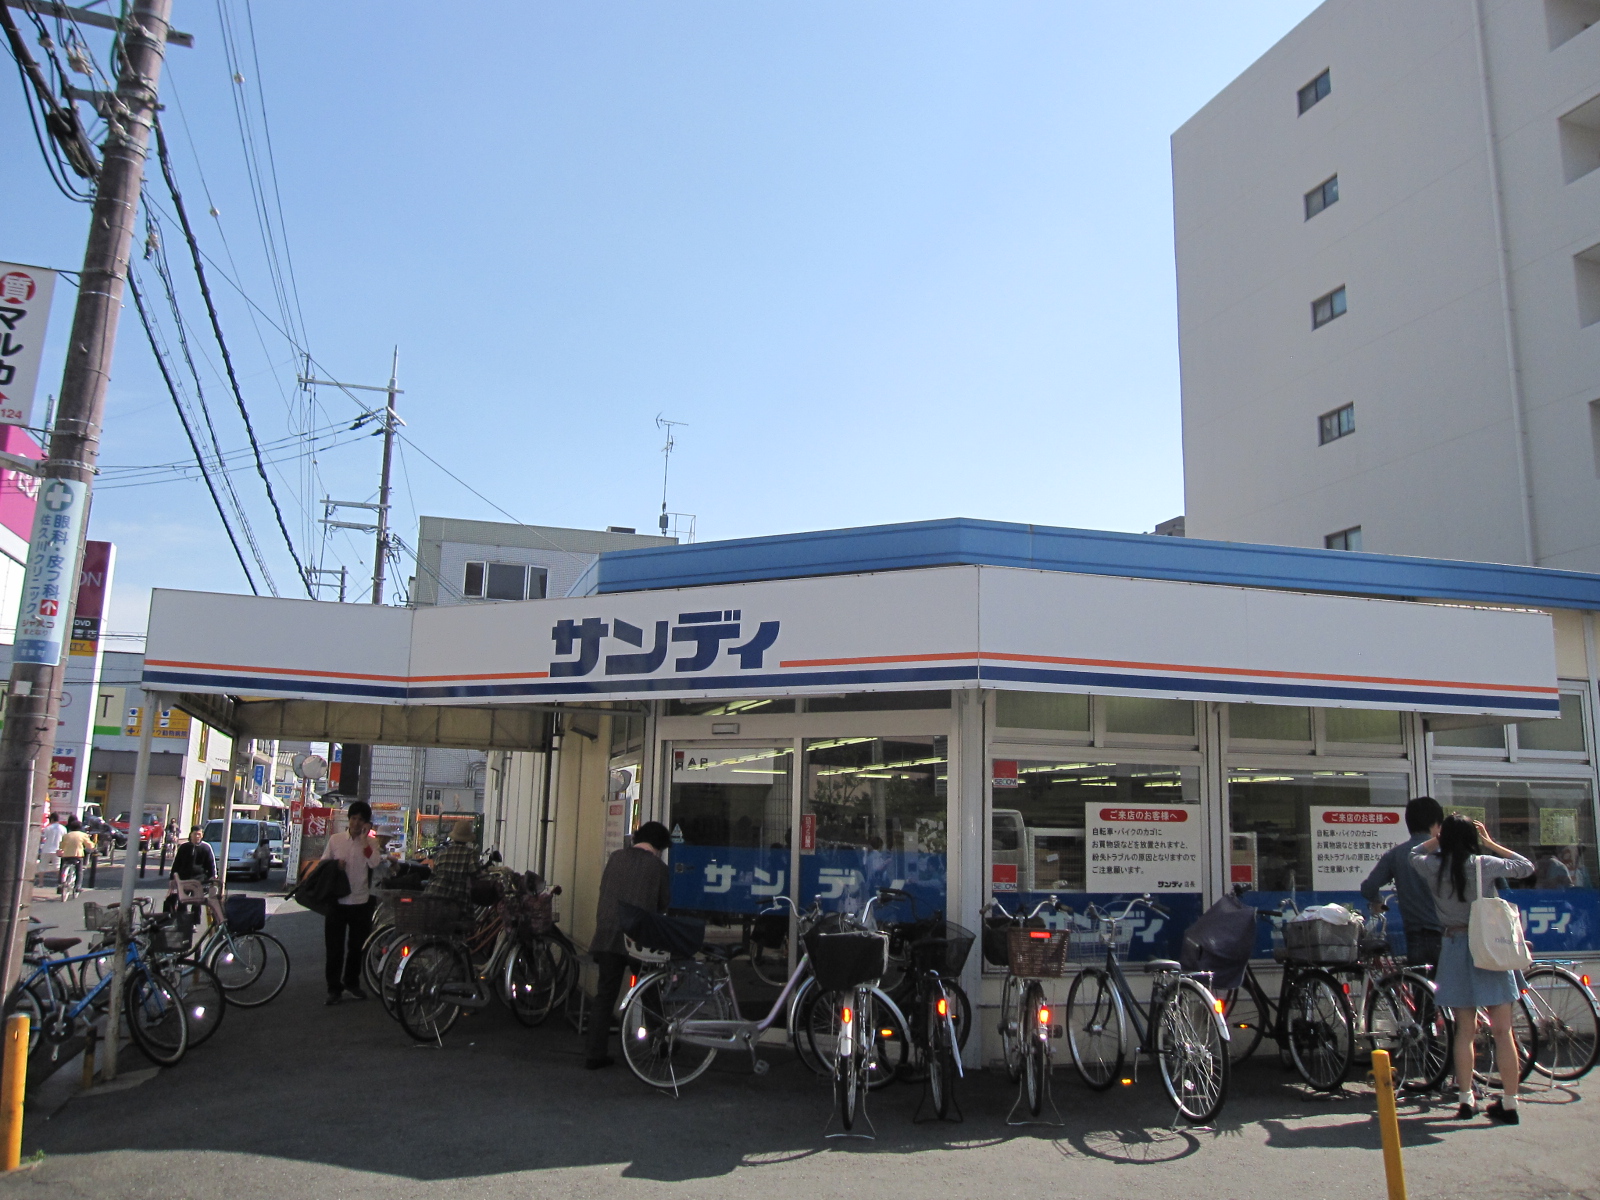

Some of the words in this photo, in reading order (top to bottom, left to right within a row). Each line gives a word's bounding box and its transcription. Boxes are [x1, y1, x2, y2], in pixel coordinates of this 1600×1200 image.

[550, 609, 780, 678] サンディ
[1110, 810, 1178, 821] ご来店のお客様へ
[1331, 813, 1391, 823] ご来店のお客様へ
[1092, 827, 1162, 836] 自転車・バイクのカゴに
